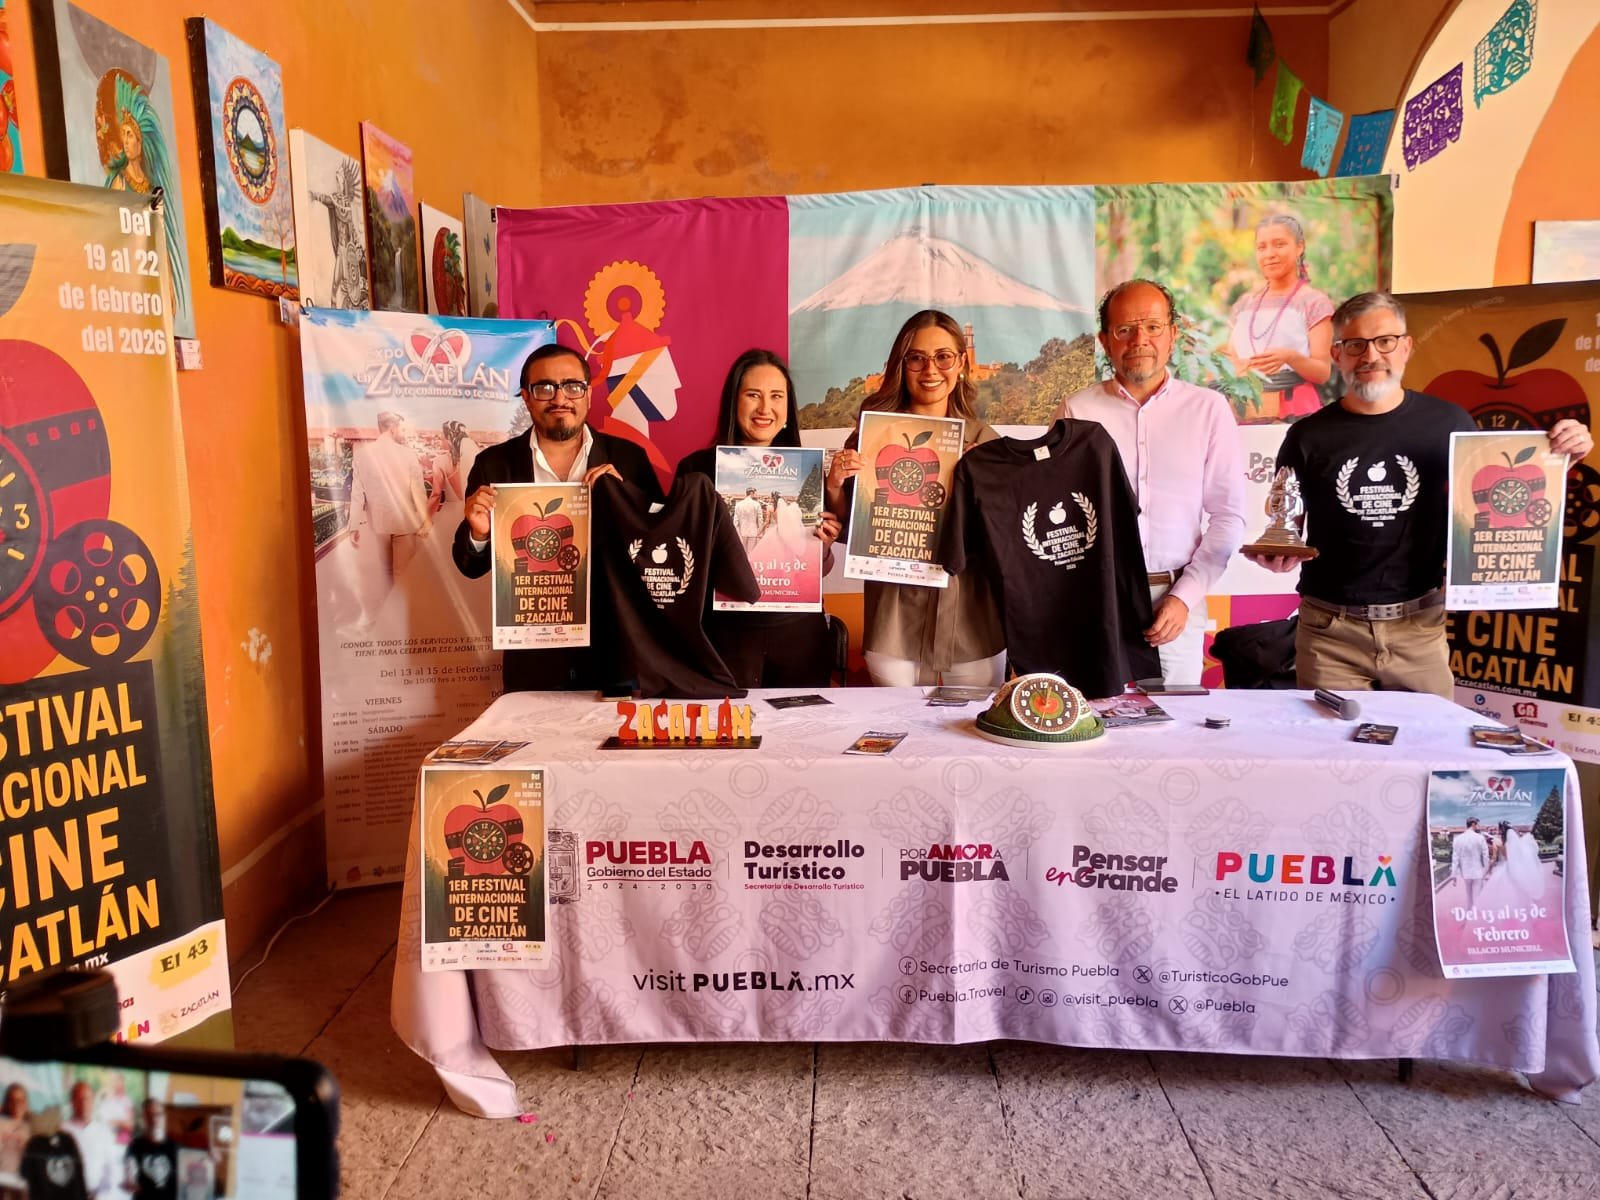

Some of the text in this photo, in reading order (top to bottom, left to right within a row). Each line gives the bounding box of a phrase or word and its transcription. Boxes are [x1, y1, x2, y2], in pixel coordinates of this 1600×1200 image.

[119, 207, 152, 236] Del
[83, 243, 160, 277] 19 al 22
[58, 282, 163, 316] de febrero
[81, 325, 114, 352] del
[119, 327, 166, 355] 2026
[1576, 335, 1592, 350] de
[1585, 357, 1600, 372] de
[365, 362, 511, 395] ZACATLÁN
[1360, 485, 1395, 494] FESTIVAL
[1362, 500, 1393, 509] DE CINE
[14, 503, 31, 530] 3
[873, 506, 936, 522] 1ER FESTIVAL
[872, 518, 934, 533] INTERNACIONAL
[1046, 525, 1078, 539] FESTIVAL
[875, 529, 928, 547] DE CINE
[1474, 530, 1544, 542] 1ER FESTIVAL
[869, 545, 932, 560] DE ZACATLÁN
[1052, 540, 1080, 553] DE CINE
[1473, 542, 1543, 553] INTERNACIONAL
[767, 559, 777, 570] al
[794, 559, 807, 571] de
[1478, 554, 1536, 569] DE CINE
[515, 574, 574, 586] 1ER FESTIVAL
[644, 568, 675, 576] FESTIVAL
[1471, 569, 1541, 582] DE ZACATLÁN
[757, 575, 791, 587] ebrero
[515, 586, 573, 596] INTERNACIONAL
[519, 596, 568, 611] DE CINE
[515, 611, 574, 623] DE ZACATLÁN
[1467, 610, 1558, 656] CINE
[380, 669, 396, 678] Del
[1451, 650, 1574, 694] ACATLÁN
[365, 697, 402, 706] VIERNES
[617, 695, 751, 740] ZACATLÁN
[1517, 703, 1535, 718] GR
[1568, 713, 1581, 723] El
[0, 682, 142, 760] TIVAL
[368, 725, 403, 735] SÁBADO
[0, 745, 146, 821] CIONAL
[586, 840, 711, 865] PUEBLA
[744, 840, 865, 858] Desarrollo
[900, 844, 1002, 860] POR AMOR A
[0, 806, 125, 910] INE
[1072, 845, 1168, 872] Pensar
[587, 866, 712, 878] Gobierno del Estado
[744, 861, 846, 880] Turístico
[900, 860, 1010, 883] PUEBLA
[1215, 852, 1397, 887] PUEBLA
[448, 879, 526, 892] 1ER FESTIVAL
[1046, 866, 1178, 893] en Grande
[449, 893, 526, 904] INTERNACIONAL
[1224, 888, 1387, 905] EL LATIDO DE MÉXICO
[455, 906, 518, 923] DE CINE
[1451, 901, 1547, 922] Del 13 al 15 de
[0, 878, 160, 983] ATLÁN
[449, 925, 527, 937] DE ZACATLÁN
[1473, 927, 1529, 943] Febrero
[160, 939, 209, 973] El 43
[920, 958, 1289, 987] Secretaría de Turismo Puebla @TuristicoGobPue
[180, 989, 220, 1017] ZACATLÁN
[919, 985, 1256, 1014] Puebla.Travel @visit_puebla @Puebla
